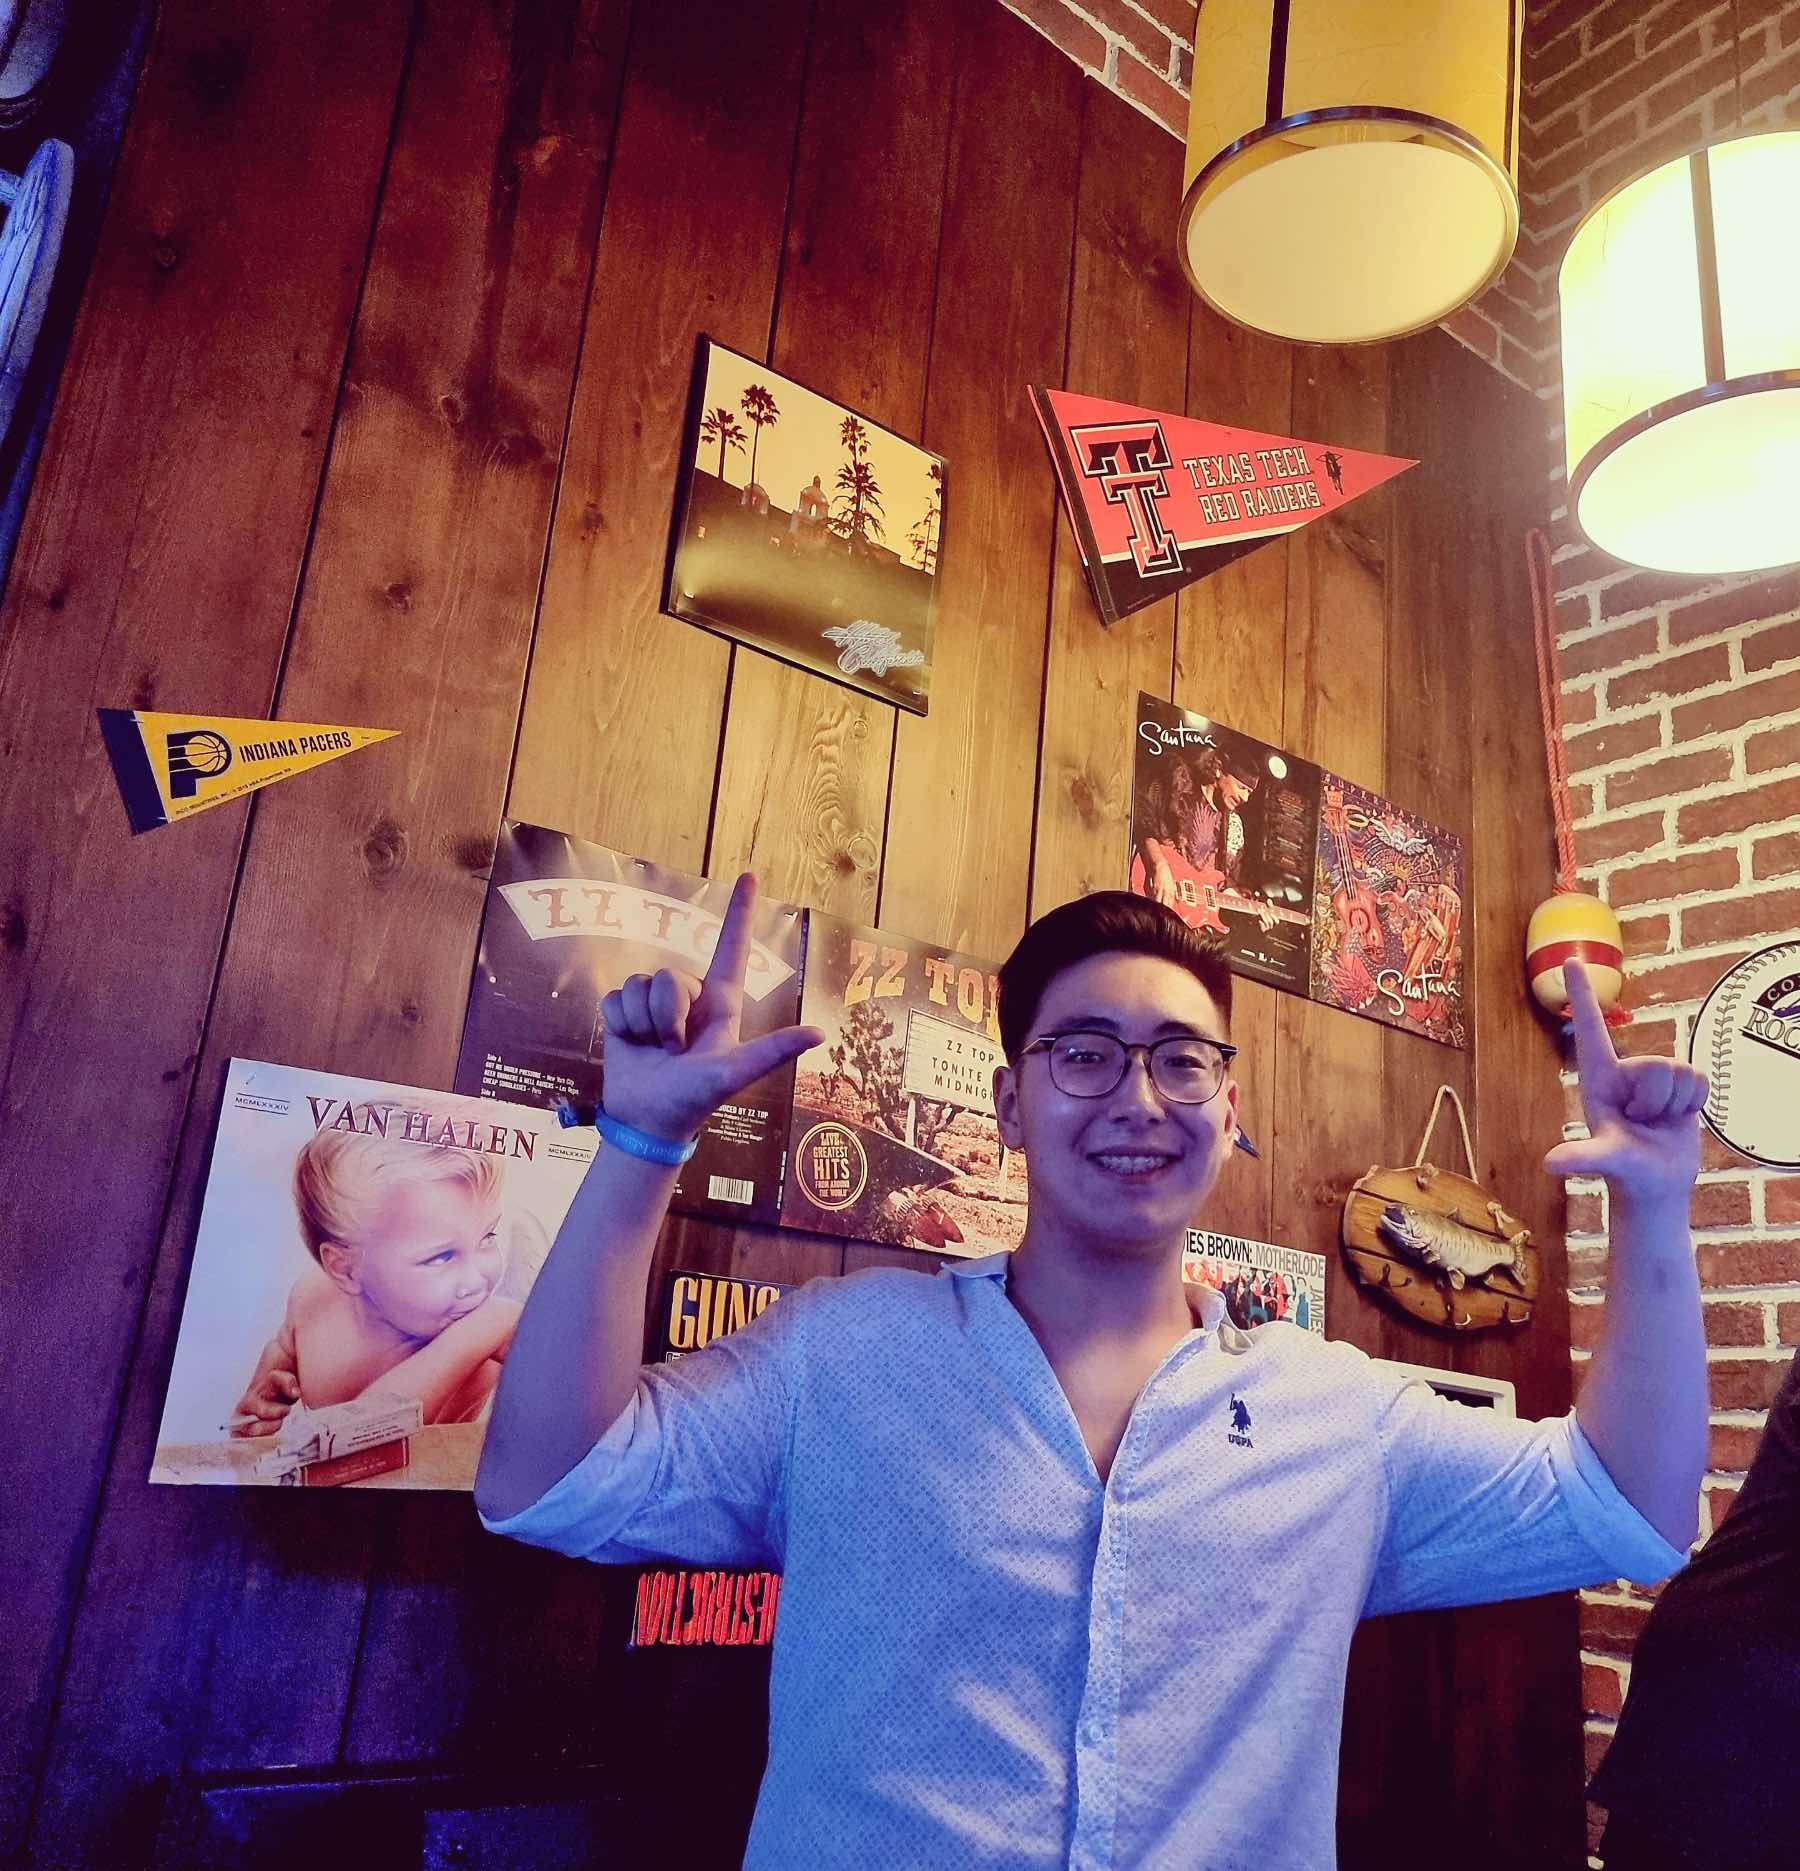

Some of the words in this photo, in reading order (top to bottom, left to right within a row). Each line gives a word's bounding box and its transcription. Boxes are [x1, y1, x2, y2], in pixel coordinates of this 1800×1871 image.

[1182, 452, 1257, 489] TEXAS
[1257, 447, 1311, 479] TECH
[1198, 493, 1242, 524] RED
[1243, 482, 1321, 518] RAIDERS
[240, 738, 298, 764] INDIANA
[301, 731, 352, 755] PACERS
[1138, 720, 1217, 755] Santana
[527, 887, 624, 929] ZZ
[843, 939, 909, 1007] ZZ
[1377, 968, 1462, 1016] Santana
[932, 1057, 984, 1082] TONITE
[946, 1039, 963, 1055] ZZ
[971, 1047, 995, 1063] TOP
[305, 1095, 393, 1139] VAN
[399, 1110, 539, 1161] HALEN
[738, 1106, 746, 1115] BY
[748, 1108, 756, 1117] ZZ
[757, 1110, 769, 1119] TOP
[813, 1146, 848, 1158] GREATEST
[813, 1158, 850, 1180] HITS
[1207, 1235, 1252, 1264] BROWN:
[1256, 1245, 1325, 1279] MOTHERLODE
